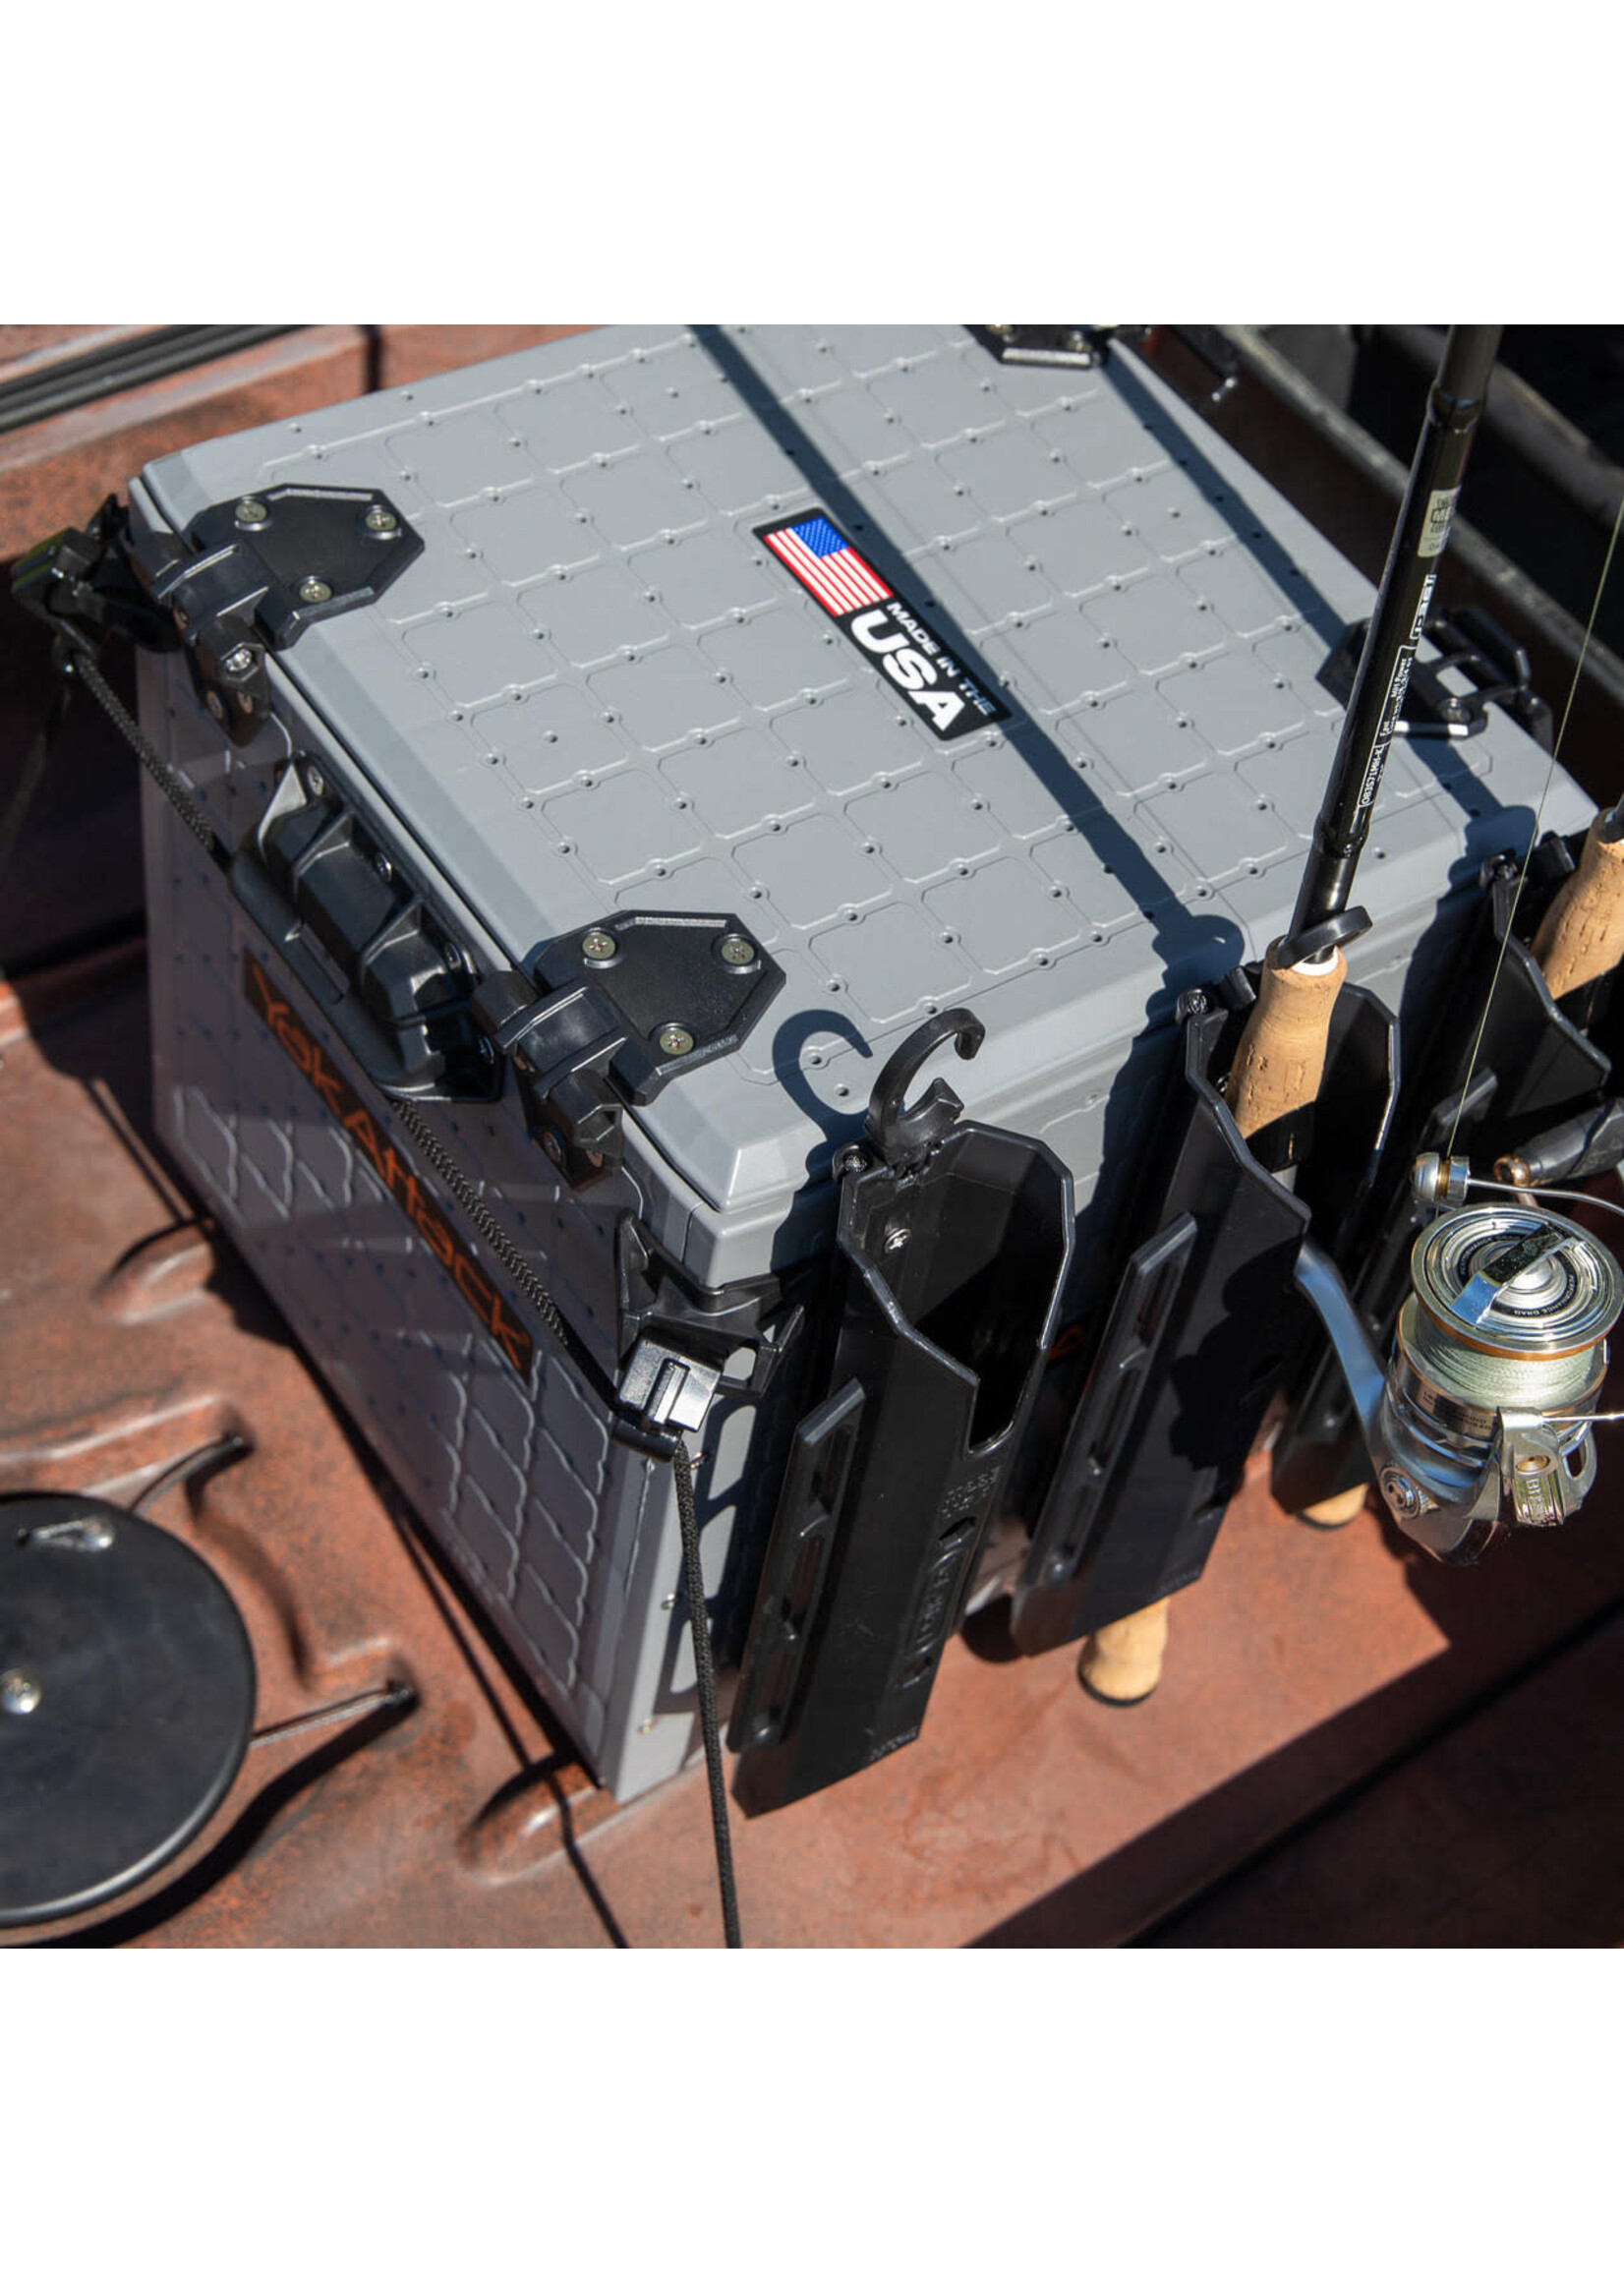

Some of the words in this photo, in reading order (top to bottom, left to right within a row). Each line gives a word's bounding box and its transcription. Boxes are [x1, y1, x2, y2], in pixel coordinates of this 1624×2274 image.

[850, 609, 965, 731] USA
[887, 602, 940, 656] MADE
[936, 656, 960, 678] IN
[959, 677, 996, 716] THE
[250, 960, 532, 1370] YakAttack
